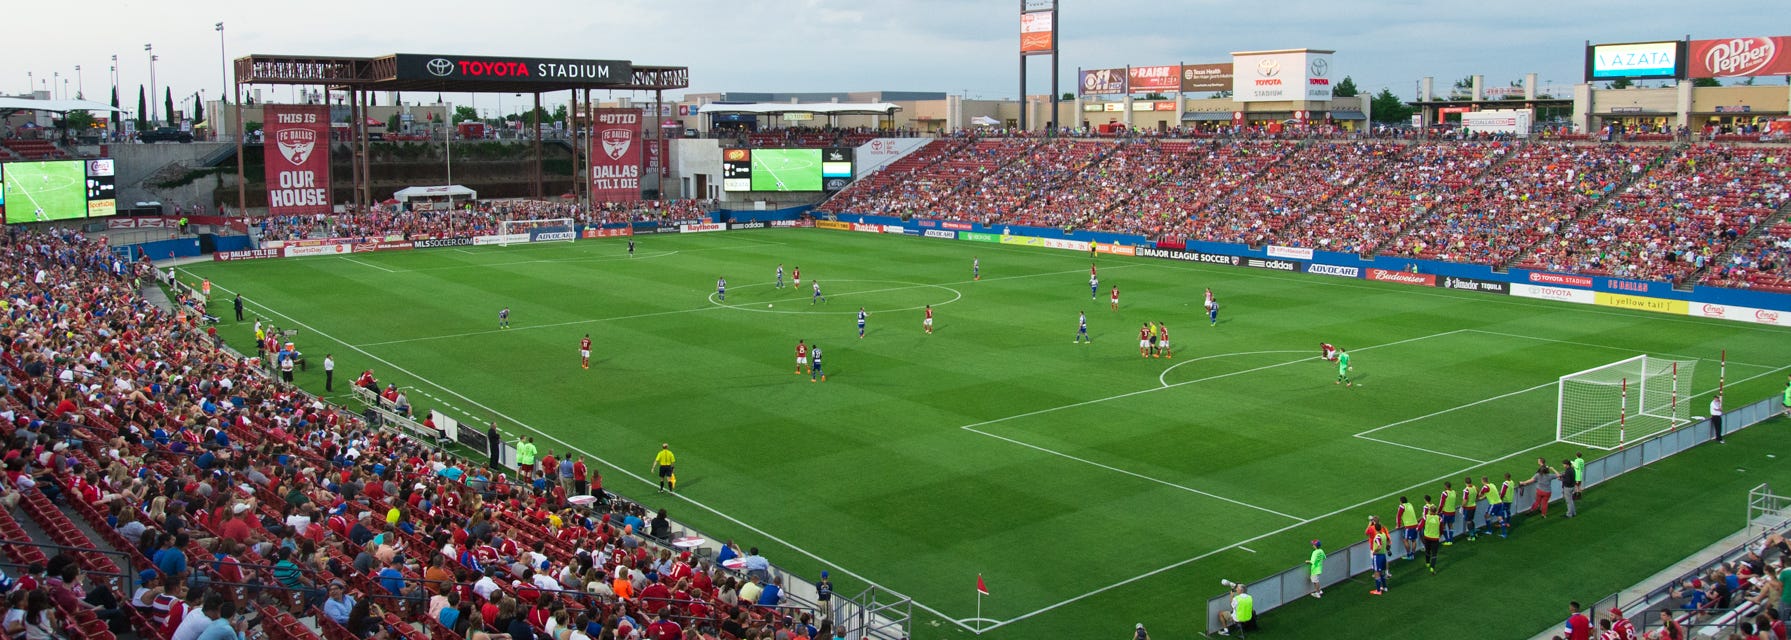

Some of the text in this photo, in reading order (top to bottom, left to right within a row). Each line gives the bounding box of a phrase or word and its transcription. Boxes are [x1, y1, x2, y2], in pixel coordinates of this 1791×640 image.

[1729, 39, 1754, 56] Dr
[1707, 43, 1770, 74] Pepper
[459, 60, 610, 79] TOYOTA STADIUM
[1138, 66, 1170, 78] RAISE
[278, 113, 316, 123] THIS IS
[600, 113, 636, 124] #DTID
[280, 130, 313, 140] FC DALLAS
[604, 130, 629, 139] FC DALLAS
[593, 165, 638, 179] DALLAS
[279, 170, 315, 188] OUR
[594, 178, 638, 189] 'TIL I DIE
[271, 188, 327, 207] HOUSE
[925, 230, 955, 239] ADVOCARE
[414, 238, 473, 248] MLSSOCCER.COM
[230, 250, 251, 258] DALLAS
[292, 247, 321, 255] SportsDay
[1144, 248, 1230, 264] MAJOR LEAGUE SOCCER
[1265, 260, 1294, 270] adidas
[1309, 264, 1358, 276] ADVOCARE
[1373, 269, 1425, 283] Budweiser
[1565, 277, 1592, 285] STADIUM
[1481, 282, 1502, 290] TEQUILA
[1607, 280, 1649, 292] FC DALLAS
[1541, 287, 1572, 297] TOYOTA
[1615, 297, 1645, 307] yellow
[1647, 300, 1664, 309] tail
[447, 497, 454, 507] 2
[615, 554, 621, 564] 5
